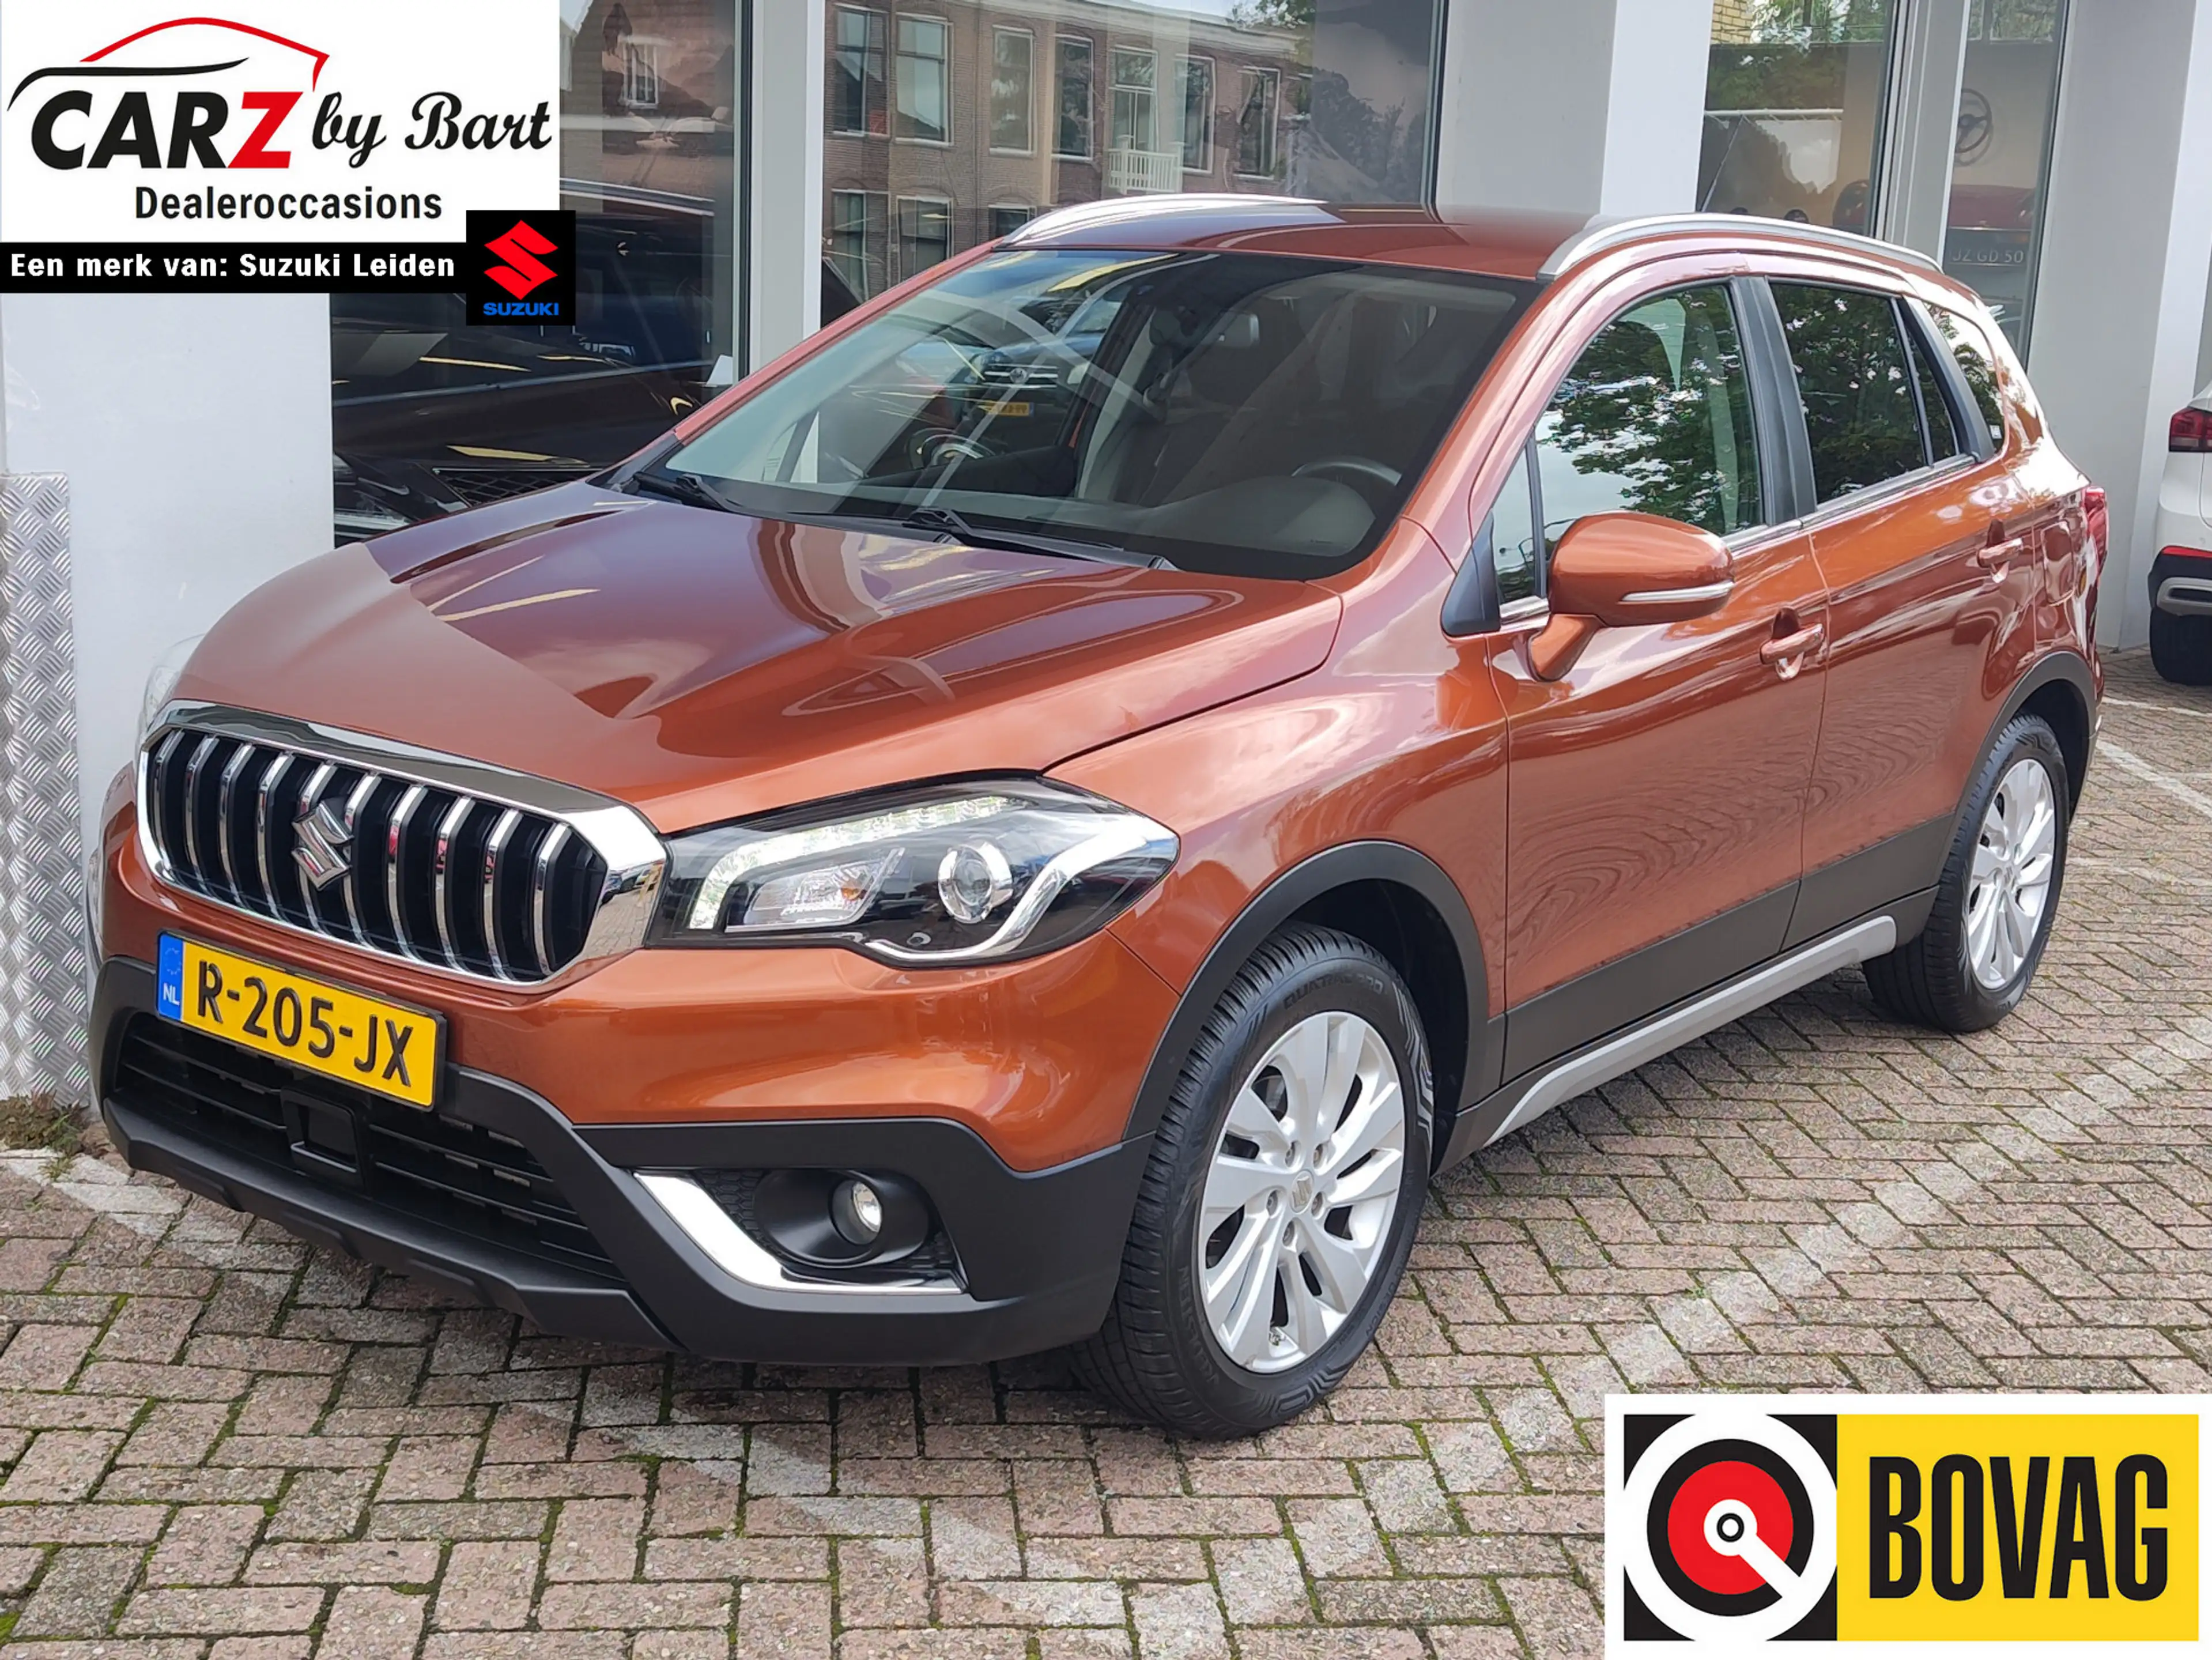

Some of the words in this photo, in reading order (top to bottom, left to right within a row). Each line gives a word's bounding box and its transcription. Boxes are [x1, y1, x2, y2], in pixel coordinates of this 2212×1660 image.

[2004, 250, 2024, 263] 50
[163, 982, 180, 1006] NL
[197, 960, 414, 1088] R-205-JX
